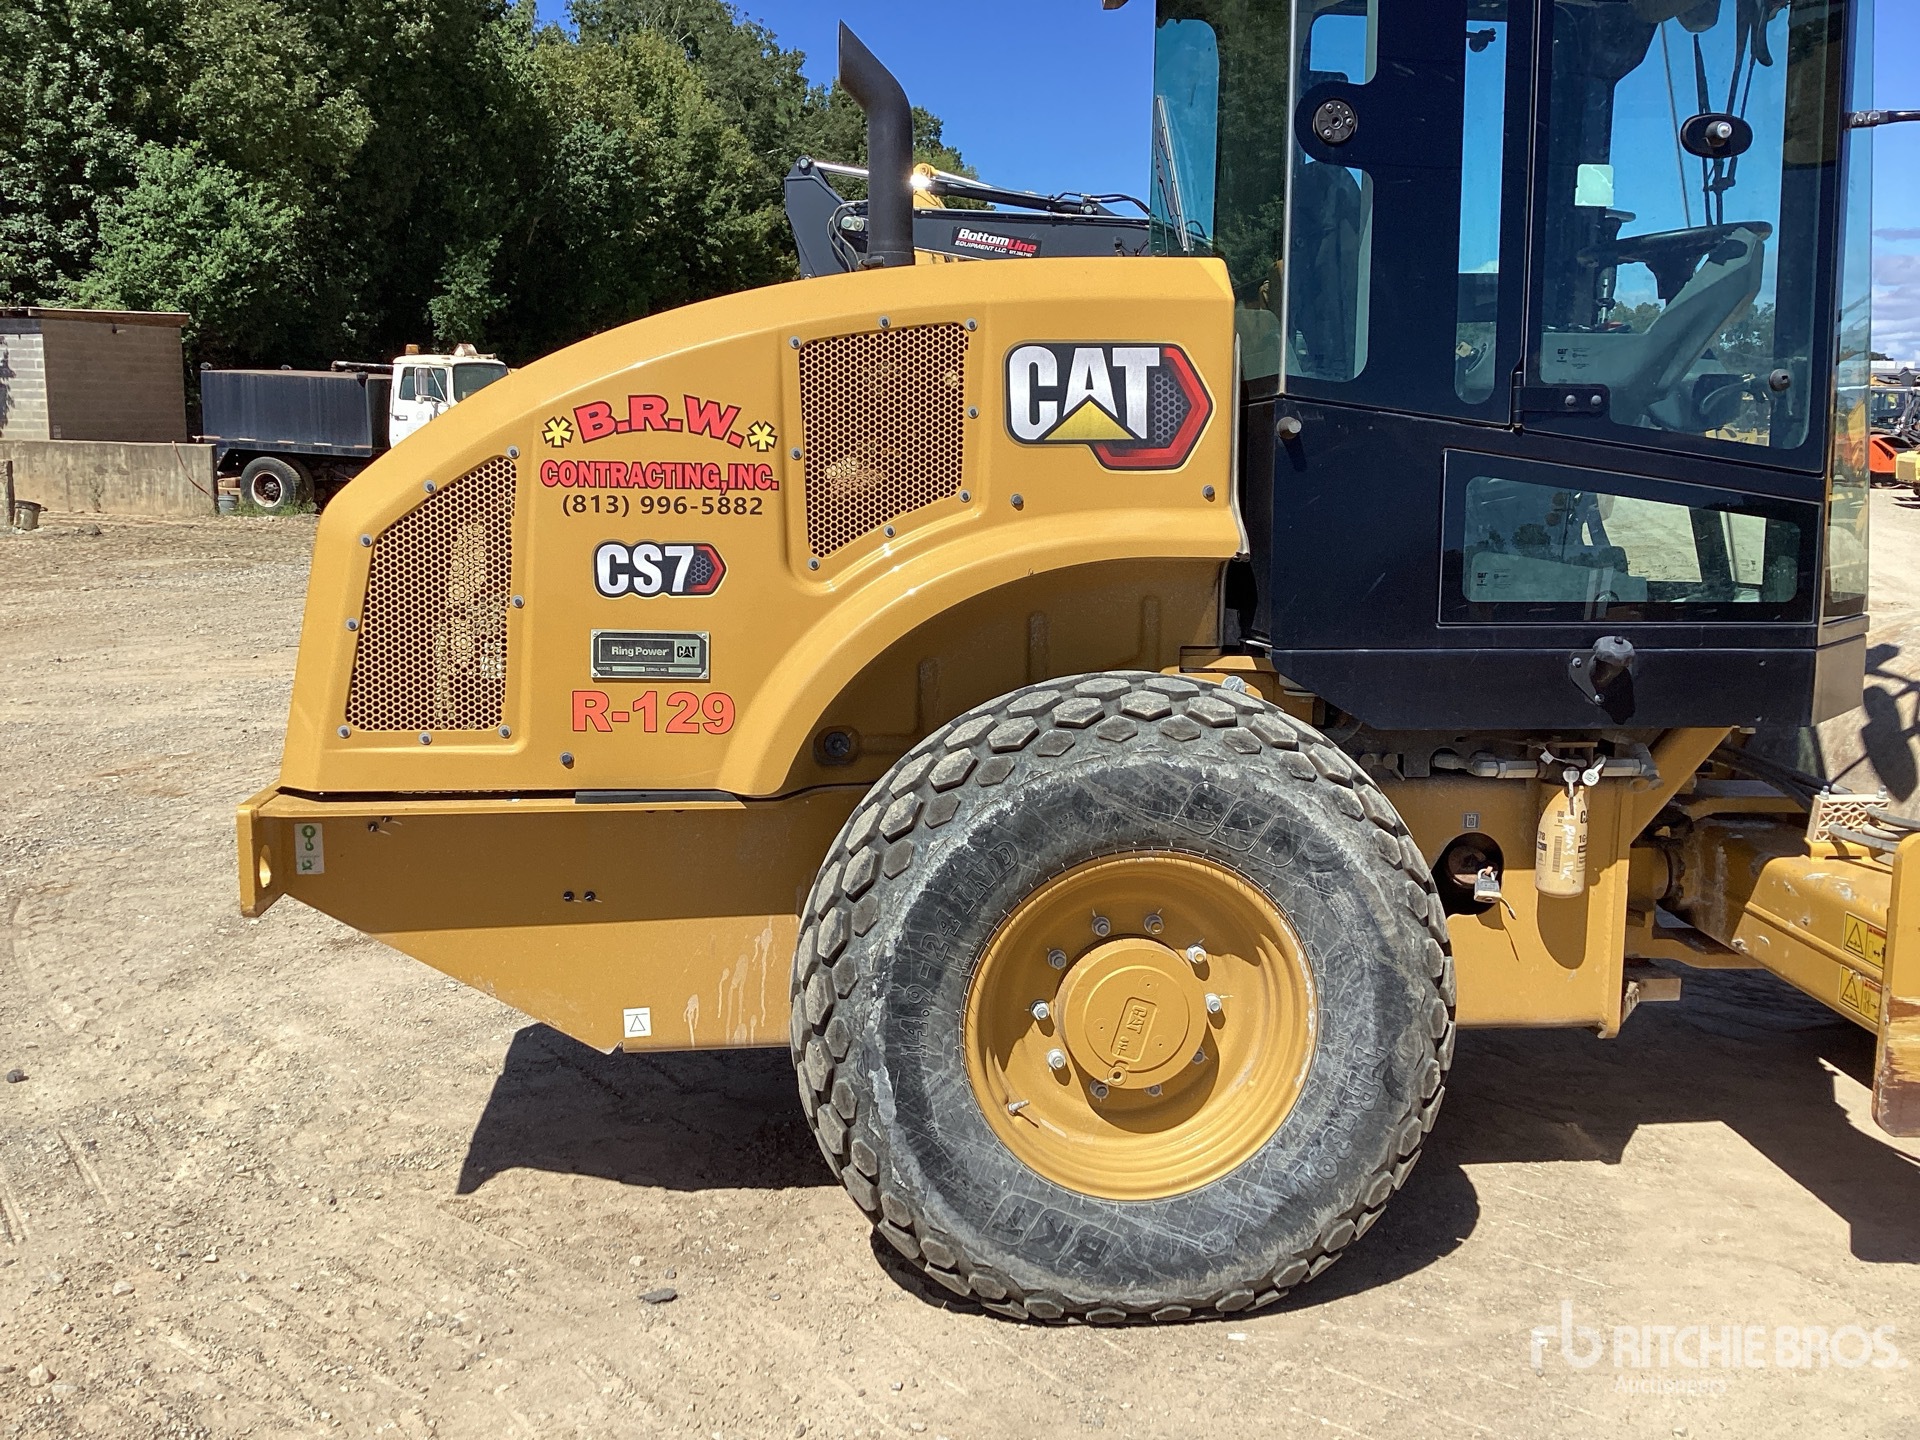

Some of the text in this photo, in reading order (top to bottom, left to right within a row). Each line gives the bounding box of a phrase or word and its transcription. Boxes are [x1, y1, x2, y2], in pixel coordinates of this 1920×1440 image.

[955, 240, 994, 252] EQUIPMENT
[1009, 345, 1161, 441] CAT
[573, 394, 746, 449] B.R.W.
[562, 494, 763, 517] (813) 996-5882
[596, 543, 695, 595] CS7
[611, 646, 669, 657] Ring Power
[676, 646, 697, 658] CAT
[572, 690, 736, 735] R-129
[950, 841, 1020, 916] IND
[1126, 1004, 1148, 1035] CAT
